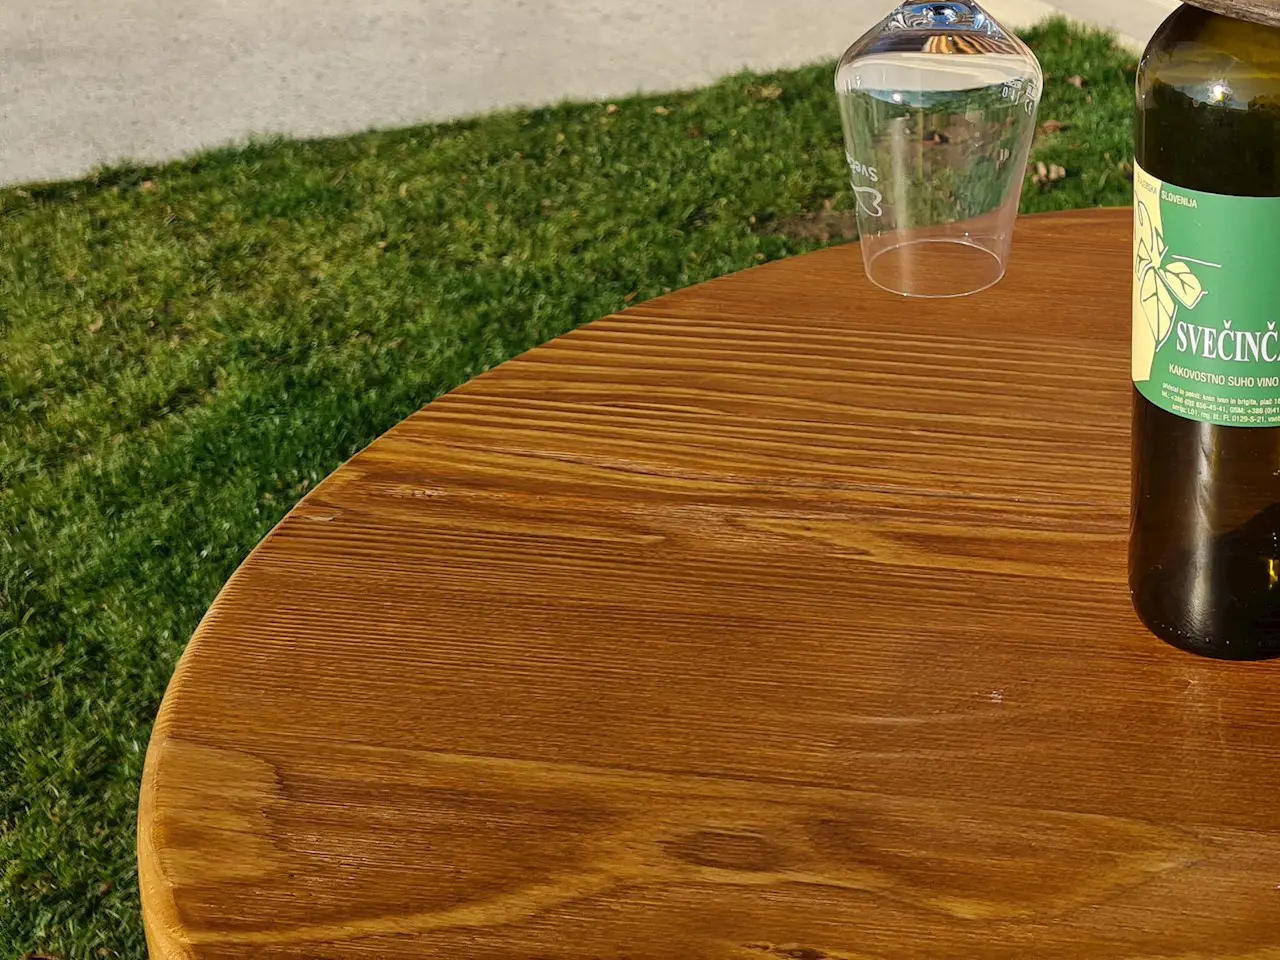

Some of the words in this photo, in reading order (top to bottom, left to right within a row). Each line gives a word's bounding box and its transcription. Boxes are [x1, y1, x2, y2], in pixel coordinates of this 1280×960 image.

[1161, 190, 1198, 209] SLOVENIJA
[1168, 363, 1225, 385] KAKOVOSTNO
[1227, 375, 1255, 387] SUHO
[1256, 376, 1279, 387] VINO
